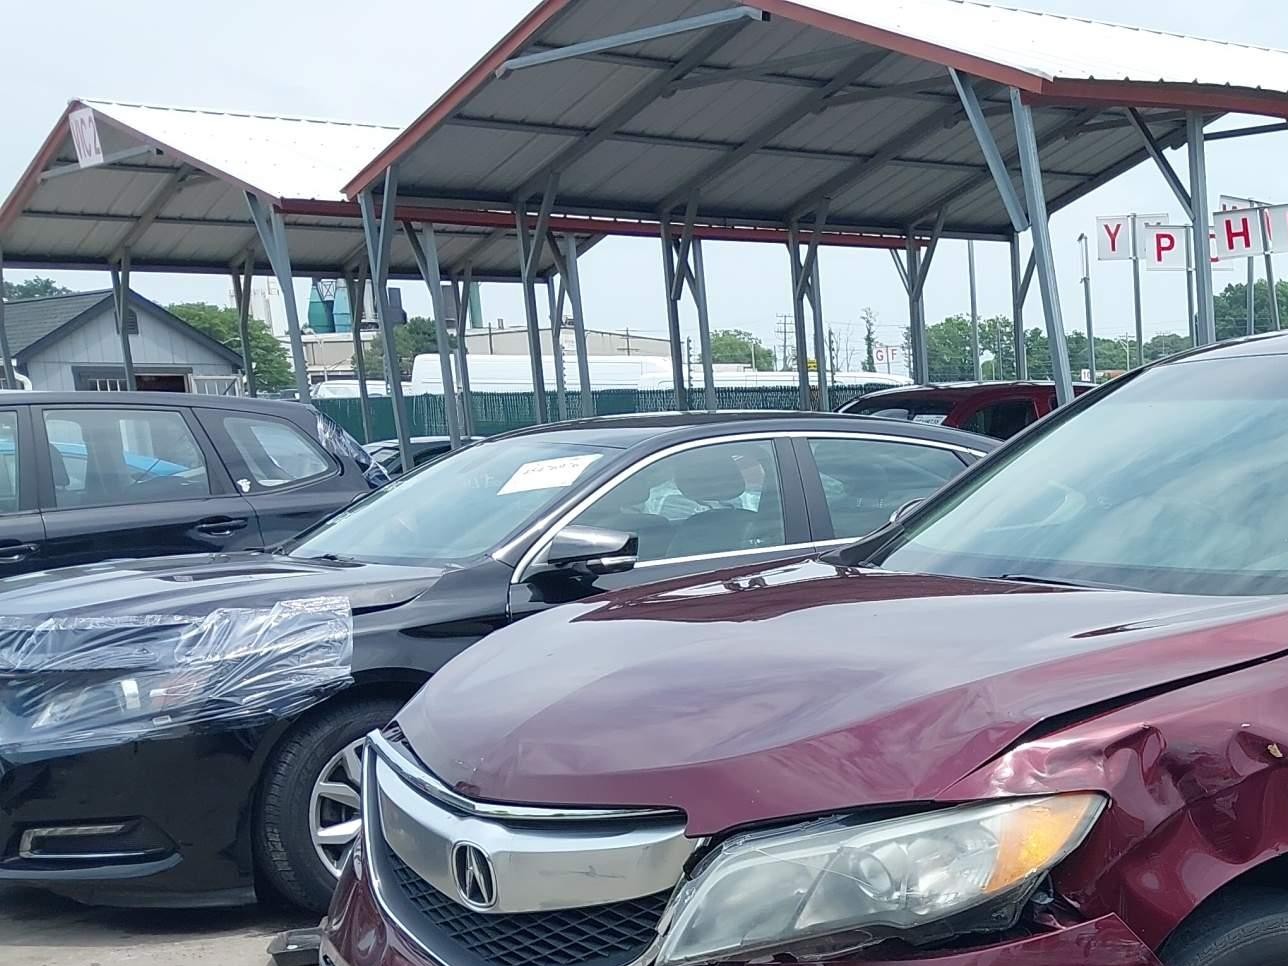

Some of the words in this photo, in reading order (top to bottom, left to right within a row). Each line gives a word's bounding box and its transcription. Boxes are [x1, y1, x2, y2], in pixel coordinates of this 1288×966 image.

[1104, 223, 1121, 252] Y
[1156, 233, 1175, 262] P
[1225, 217, 1251, 250] H
[876, 349, 885, 361] G
